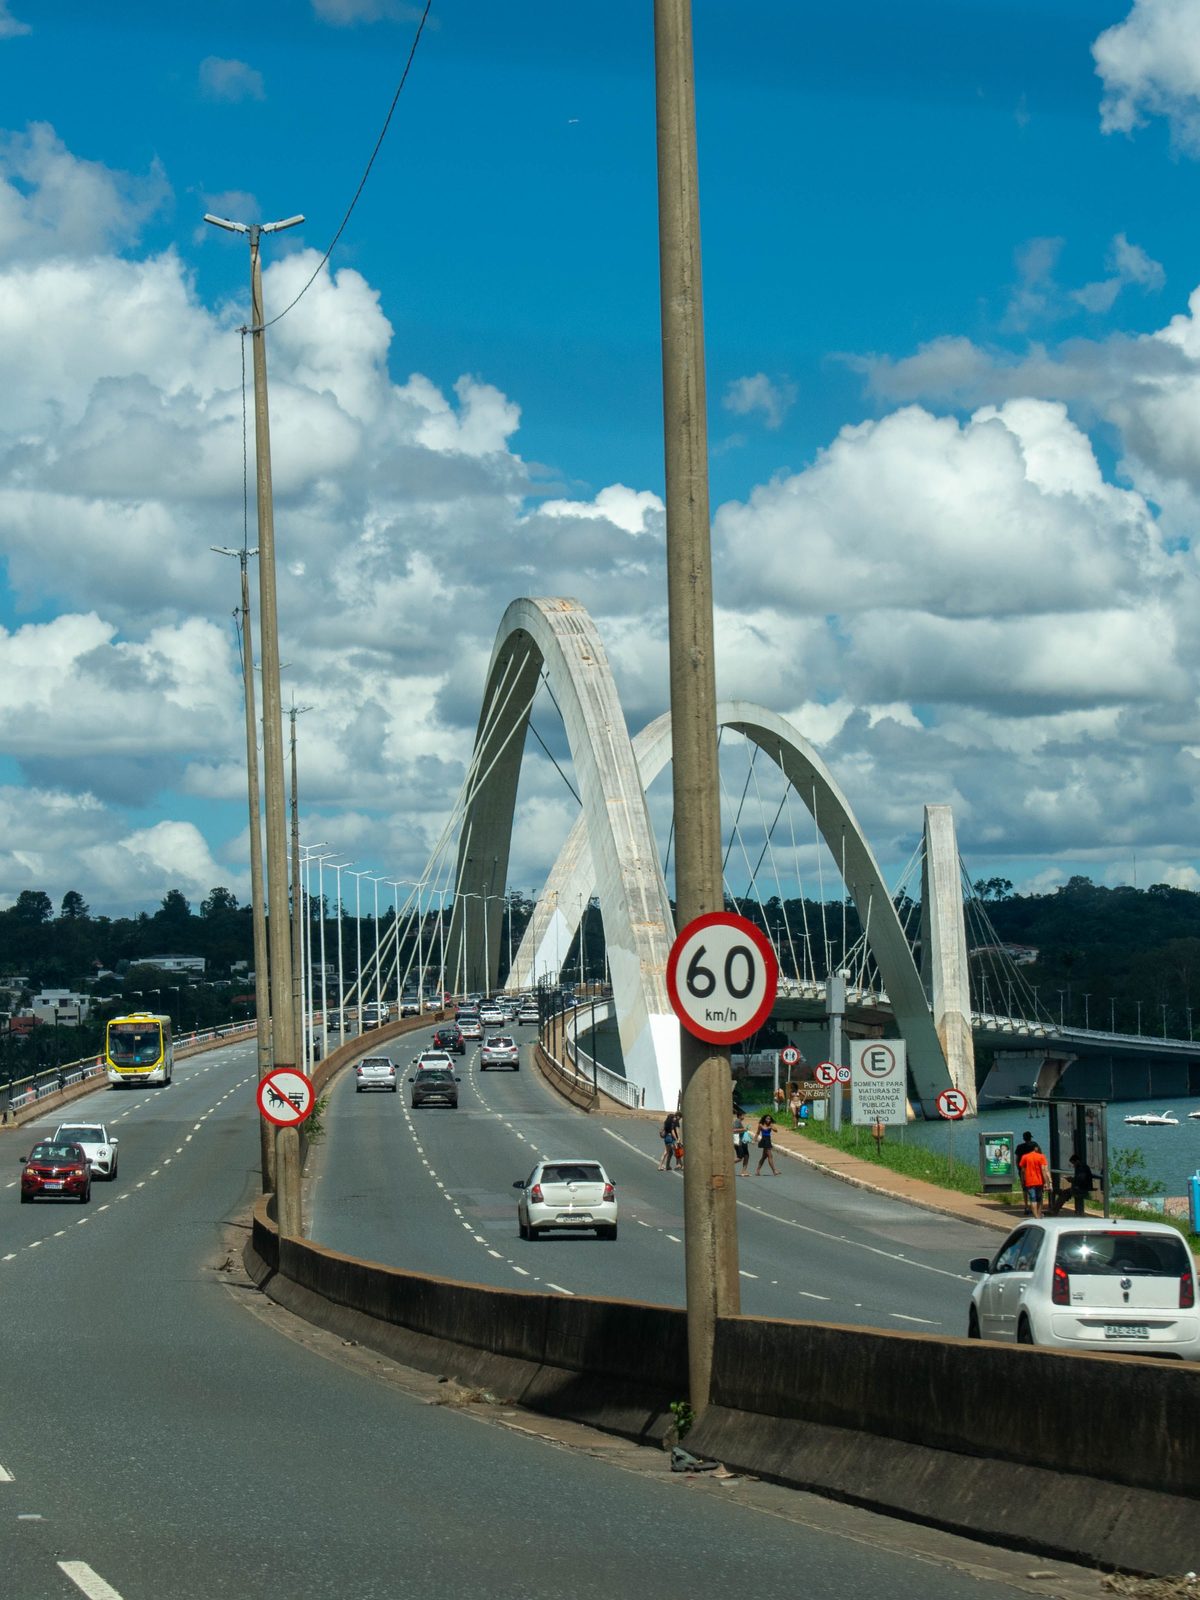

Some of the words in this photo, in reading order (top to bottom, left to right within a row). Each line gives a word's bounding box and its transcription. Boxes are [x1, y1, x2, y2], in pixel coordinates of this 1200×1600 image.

[687, 945, 755, 999] 60
[705, 1007, 737, 1022] km/h
[871, 1051, 886, 1071] E
[838, 1070, 849, 1078] 60
[947, 1094, 958, 1112] E
